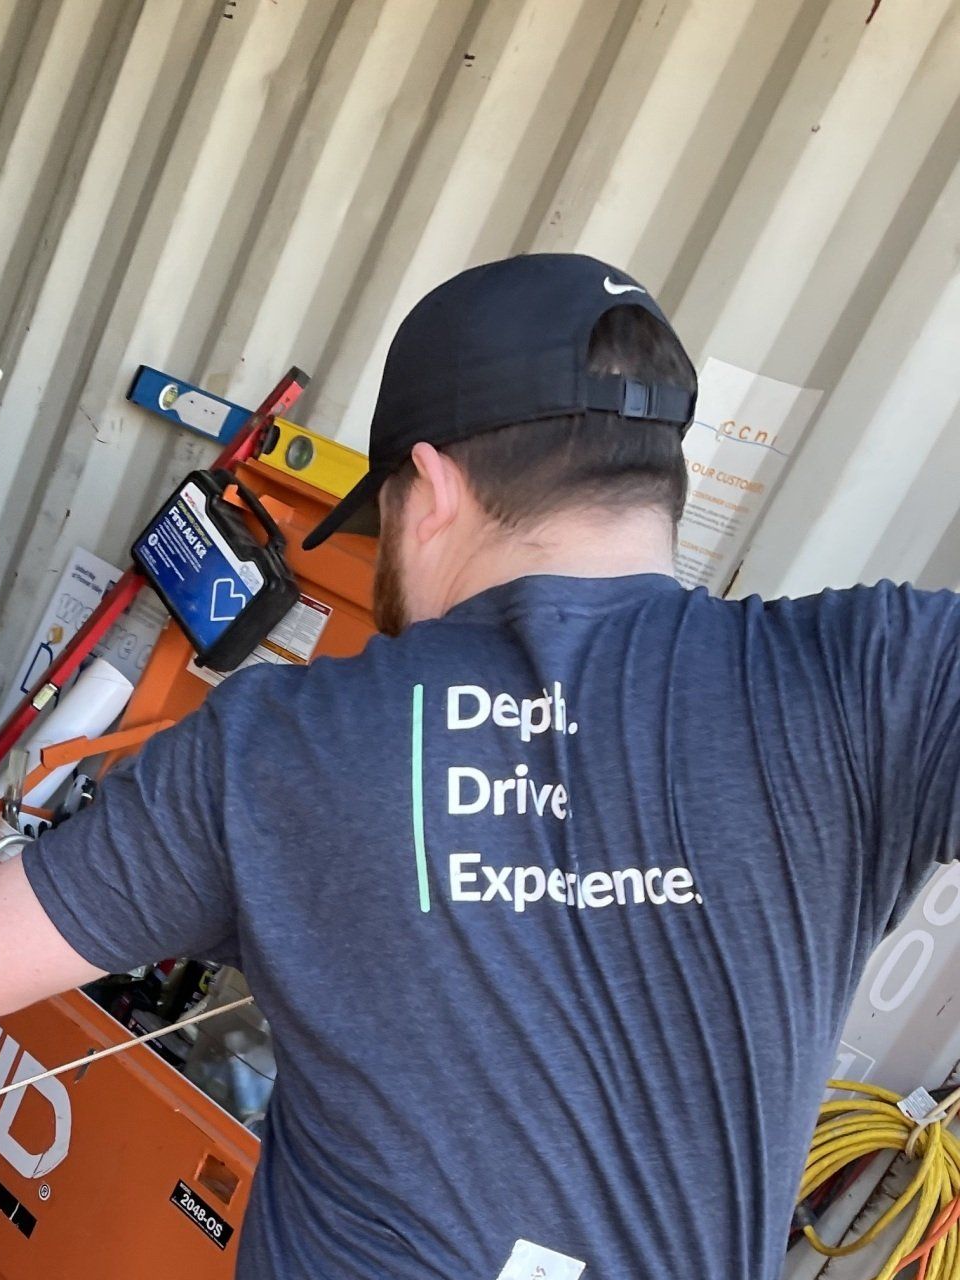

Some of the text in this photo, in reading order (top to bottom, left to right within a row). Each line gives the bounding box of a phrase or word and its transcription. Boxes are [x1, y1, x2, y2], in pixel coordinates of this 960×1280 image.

[691, 462, 716, 479] OUR
[168, 505, 187, 530] First
[182, 527, 199, 546] Aid
[193, 541, 207, 559] Kit
[448, 853, 703, 912] Experience.
[180, 1193, 224, 1238] 2048-OS
